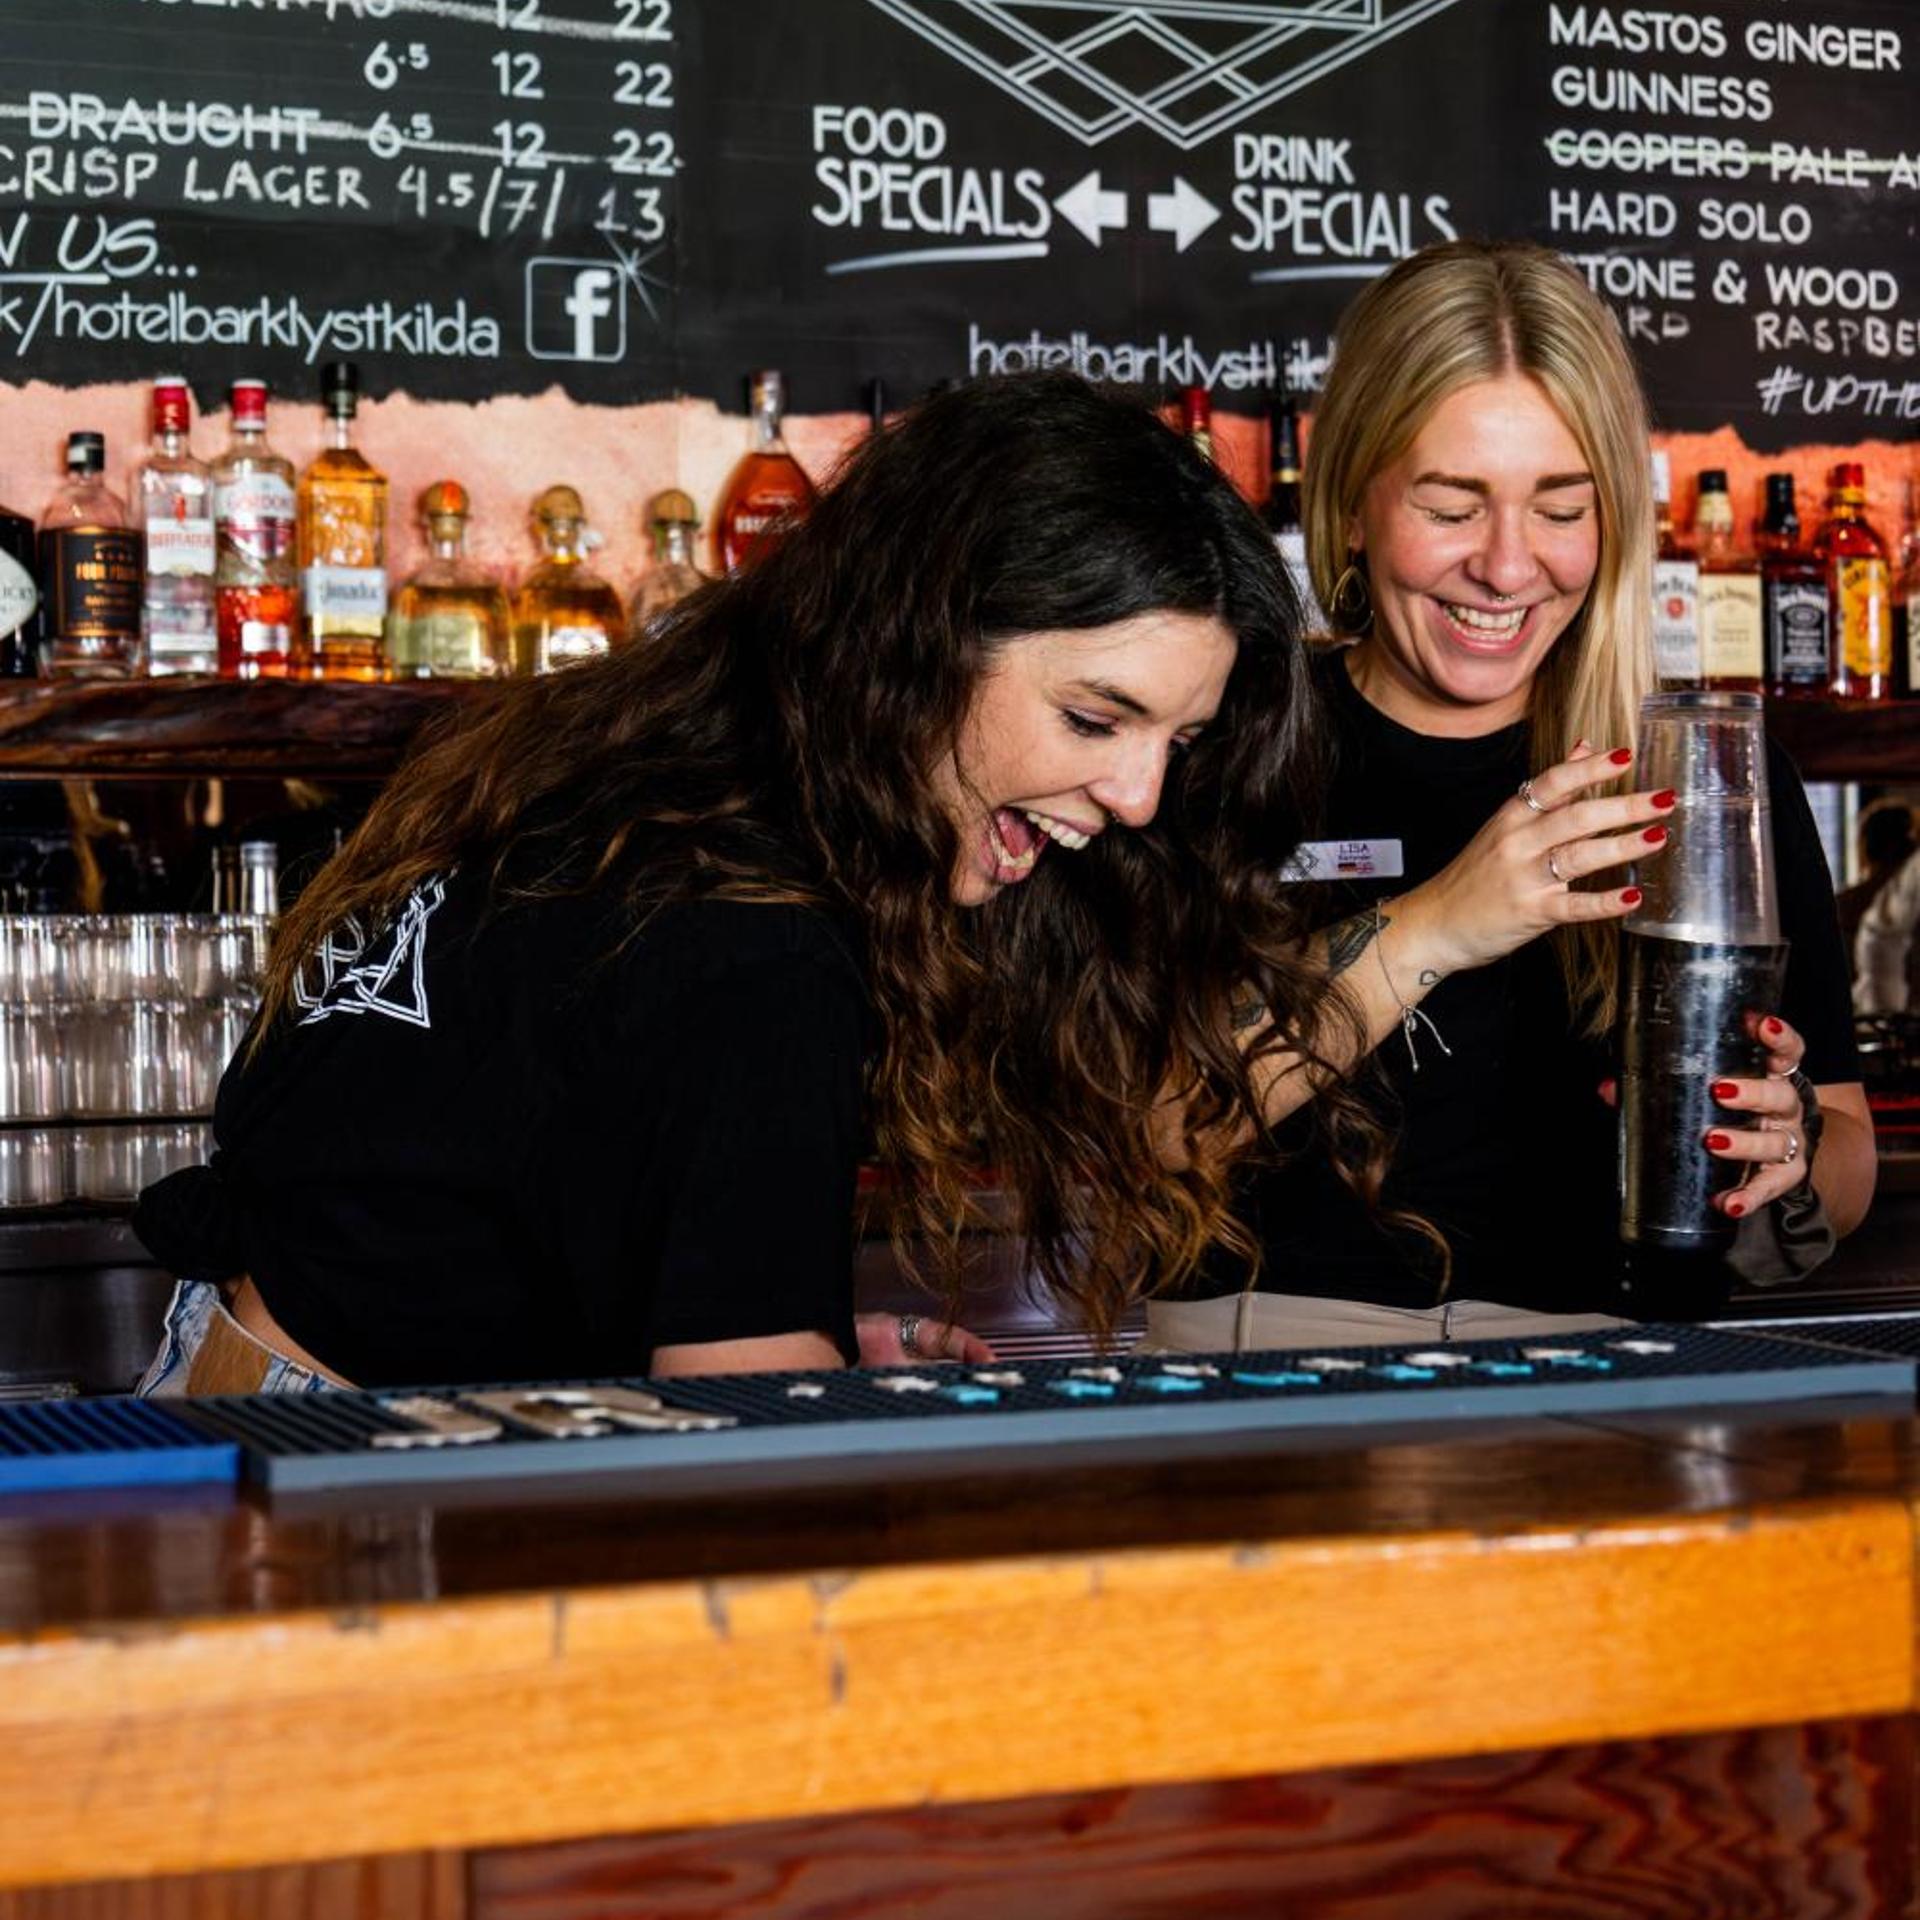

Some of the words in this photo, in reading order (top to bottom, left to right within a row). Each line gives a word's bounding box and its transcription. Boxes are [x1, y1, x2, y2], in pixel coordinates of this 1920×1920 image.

[1549, 4, 1727, 57] MASTOS
[1745, 21, 1901, 71] GINGER
[364, 41, 430, 91] 6.5
[492, 51, 545, 99] 12
[613, 61, 674, 108] 22
[1551, 65, 1773, 121] GUINNESS
[29, 91, 321, 155] DRAUGHT
[493, 119, 548, 168] 12
[611, 129, 676, 177] 22
[813, 106, 946, 160] FOOD
[1233, 133, 1354, 185] DRINK
[1549, 129, 1752, 179] COOPERS
[1770, 141, 1872, 188] PALE
[0, 145, 159, 201] CRISP
[183, 156, 372, 210] LAGER
[812, 158, 1052, 240] SPECIALS
[1230, 186, 1459, 258] SPECIALS
[1549, 188, 1678, 238] HARD
[1697, 199, 1812, 244] SOLO
[1562, 252, 1696, 300] TONE
[1712, 259, 1747, 304] &
[1765, 264, 1899, 310] WOOD
[1754, 310, 1920, 359] RASPBE
